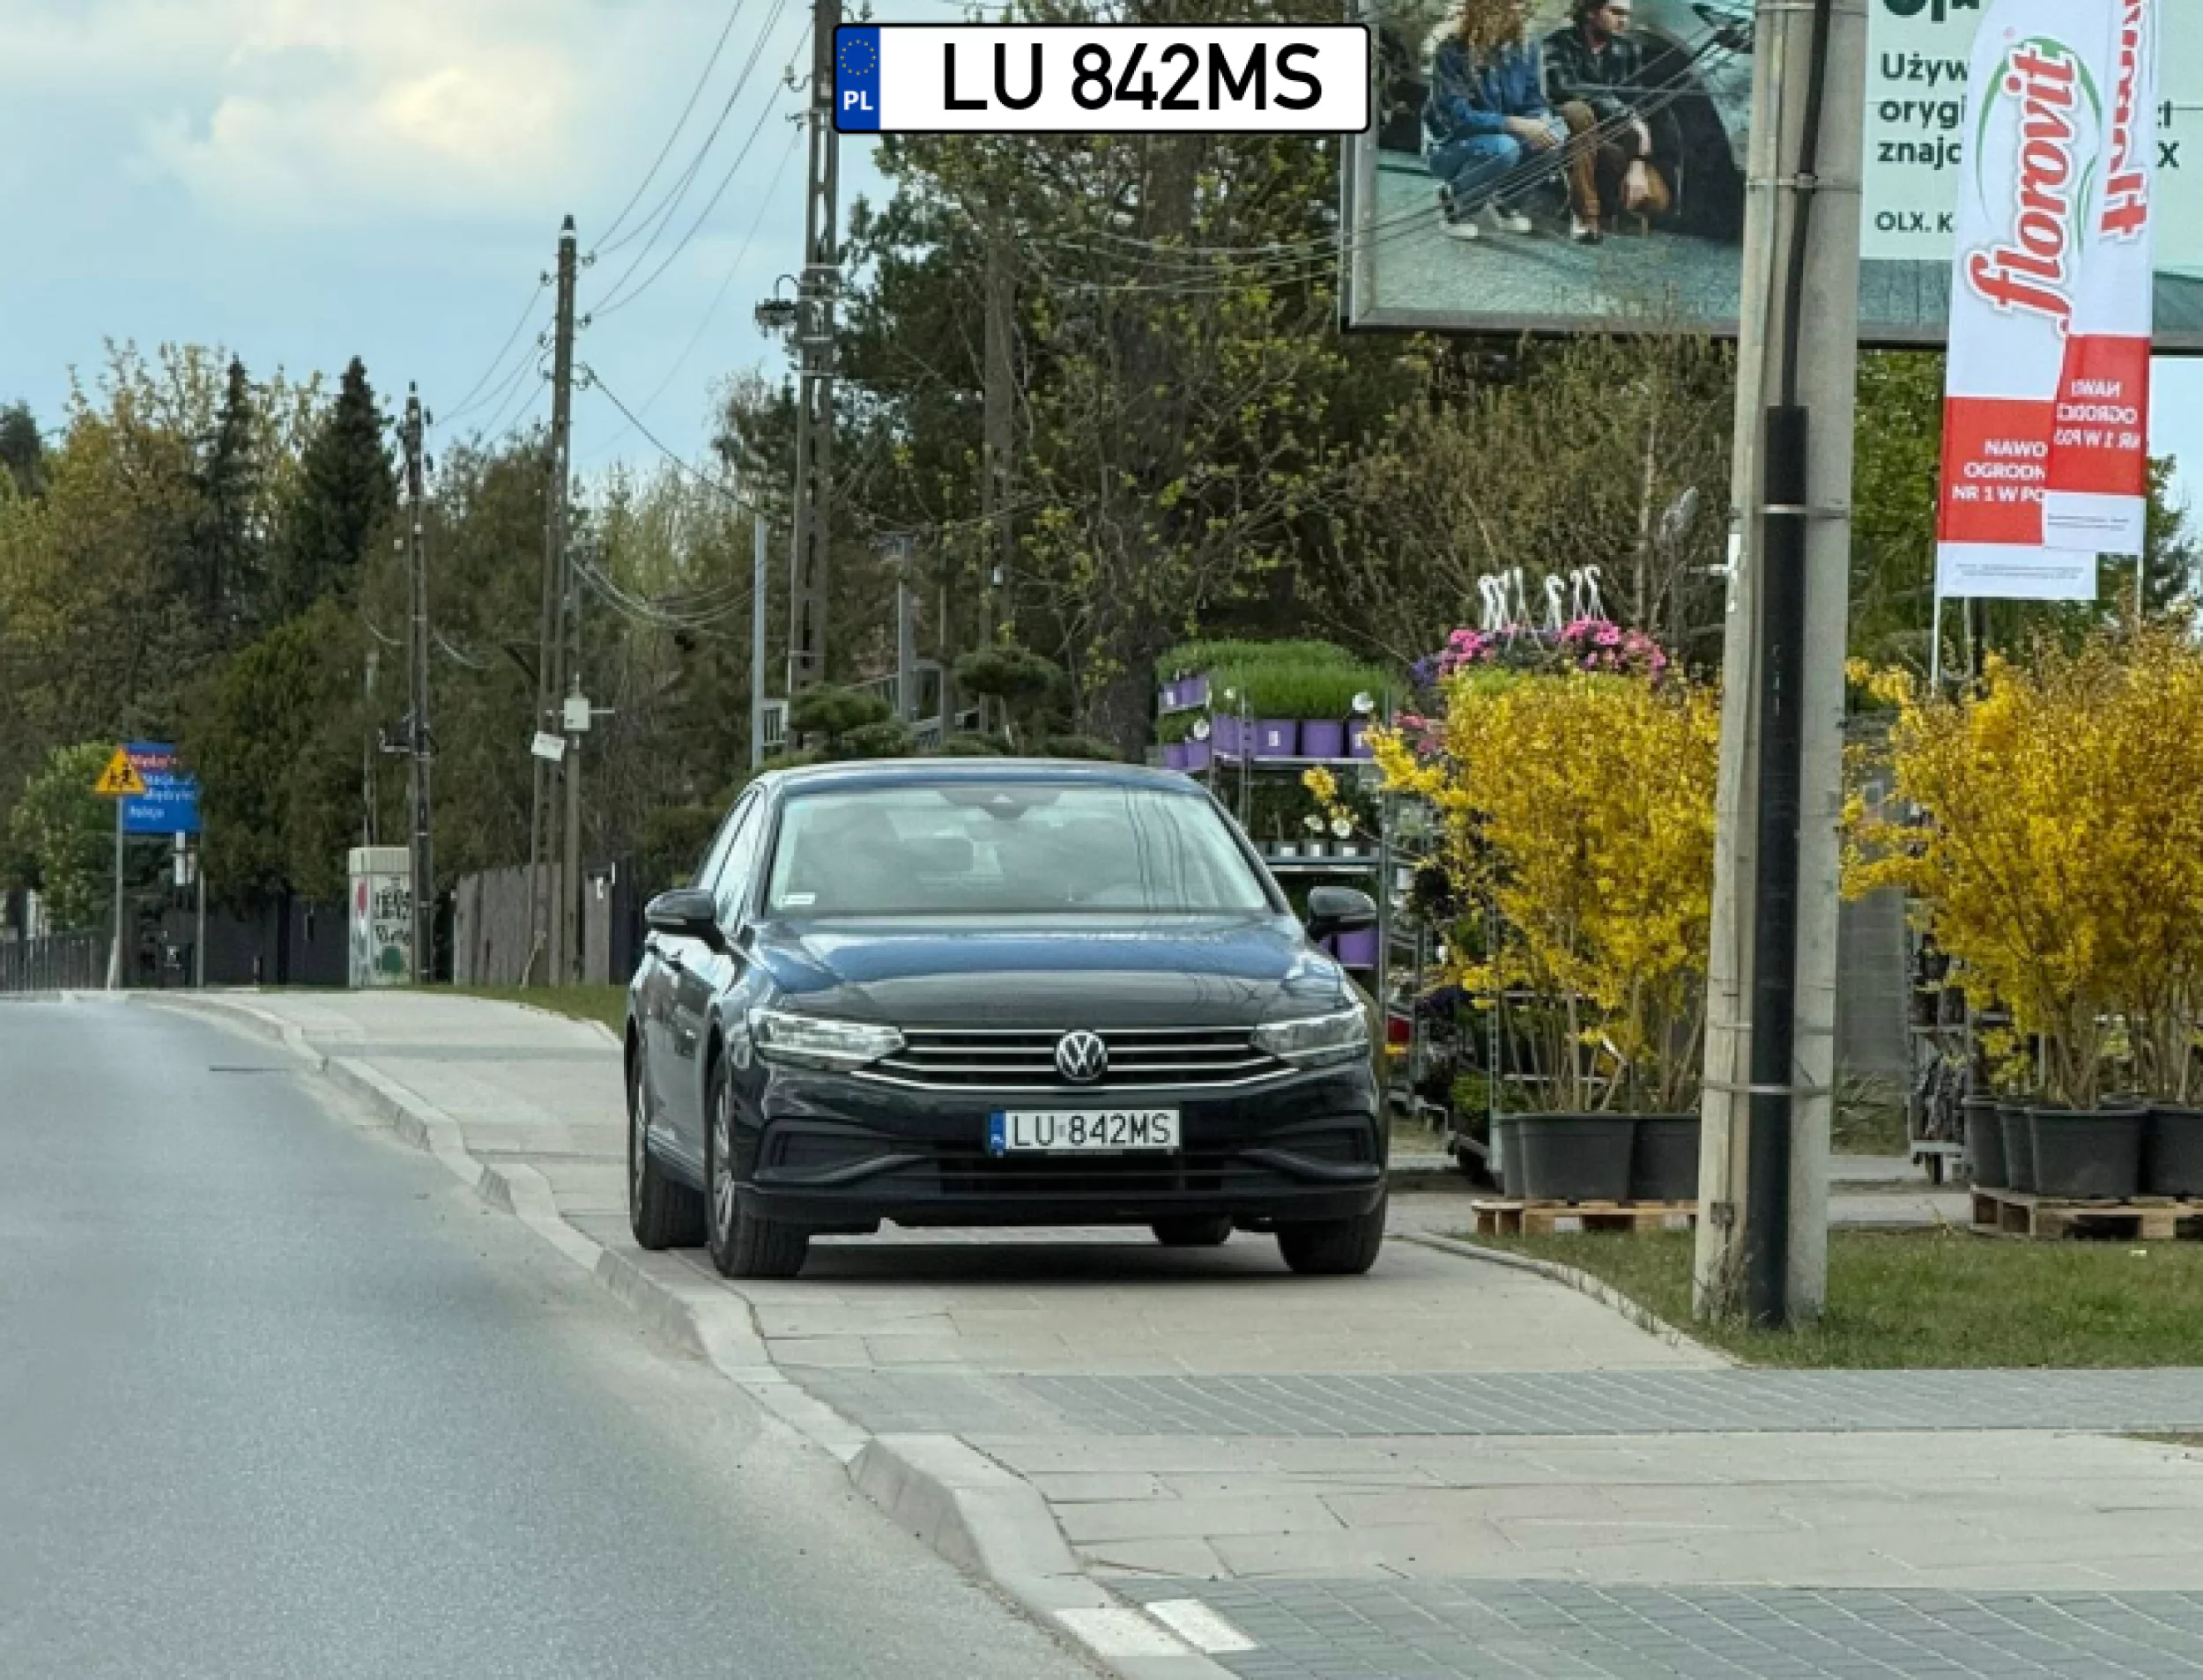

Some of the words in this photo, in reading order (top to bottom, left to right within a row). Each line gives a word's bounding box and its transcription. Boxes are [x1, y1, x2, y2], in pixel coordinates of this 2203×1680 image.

[1969, 47, 2075, 328] florovit
[1952, 485, 1979, 500] NR
[1984, 485, 1994, 502] 1
[1998, 486, 2018, 501] W
[1014, 1115, 1055, 1146] LU
[1068, 1113, 1171, 1146] 842MS
